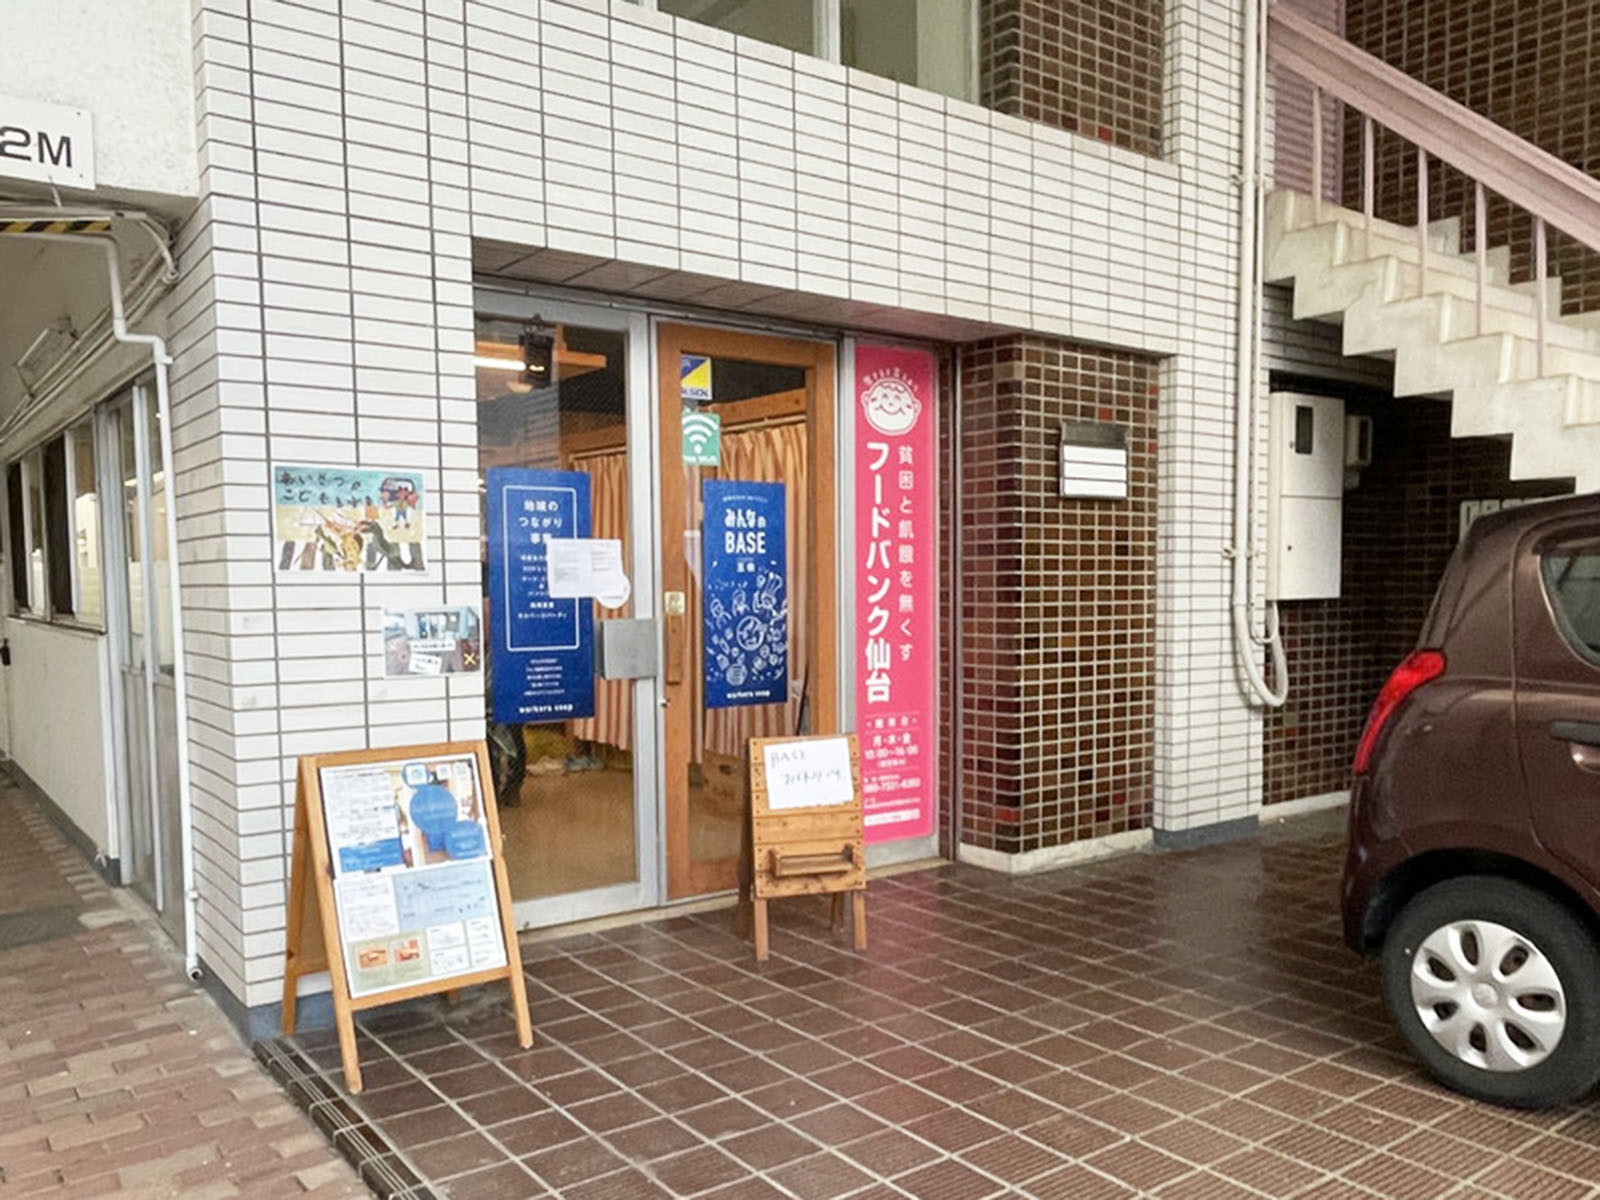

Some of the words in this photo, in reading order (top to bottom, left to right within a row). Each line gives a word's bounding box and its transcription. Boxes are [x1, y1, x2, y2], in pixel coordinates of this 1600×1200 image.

[0, 125, 72, 168] 2M
[524, 499, 559, 512] 地域の
[518, 516, 563, 529] つながり
[725, 531, 767, 554] BASE
[898, 445, 915, 661] 貧困と飢餓を無くす
[865, 441, 891, 704] フードバンク仙台
